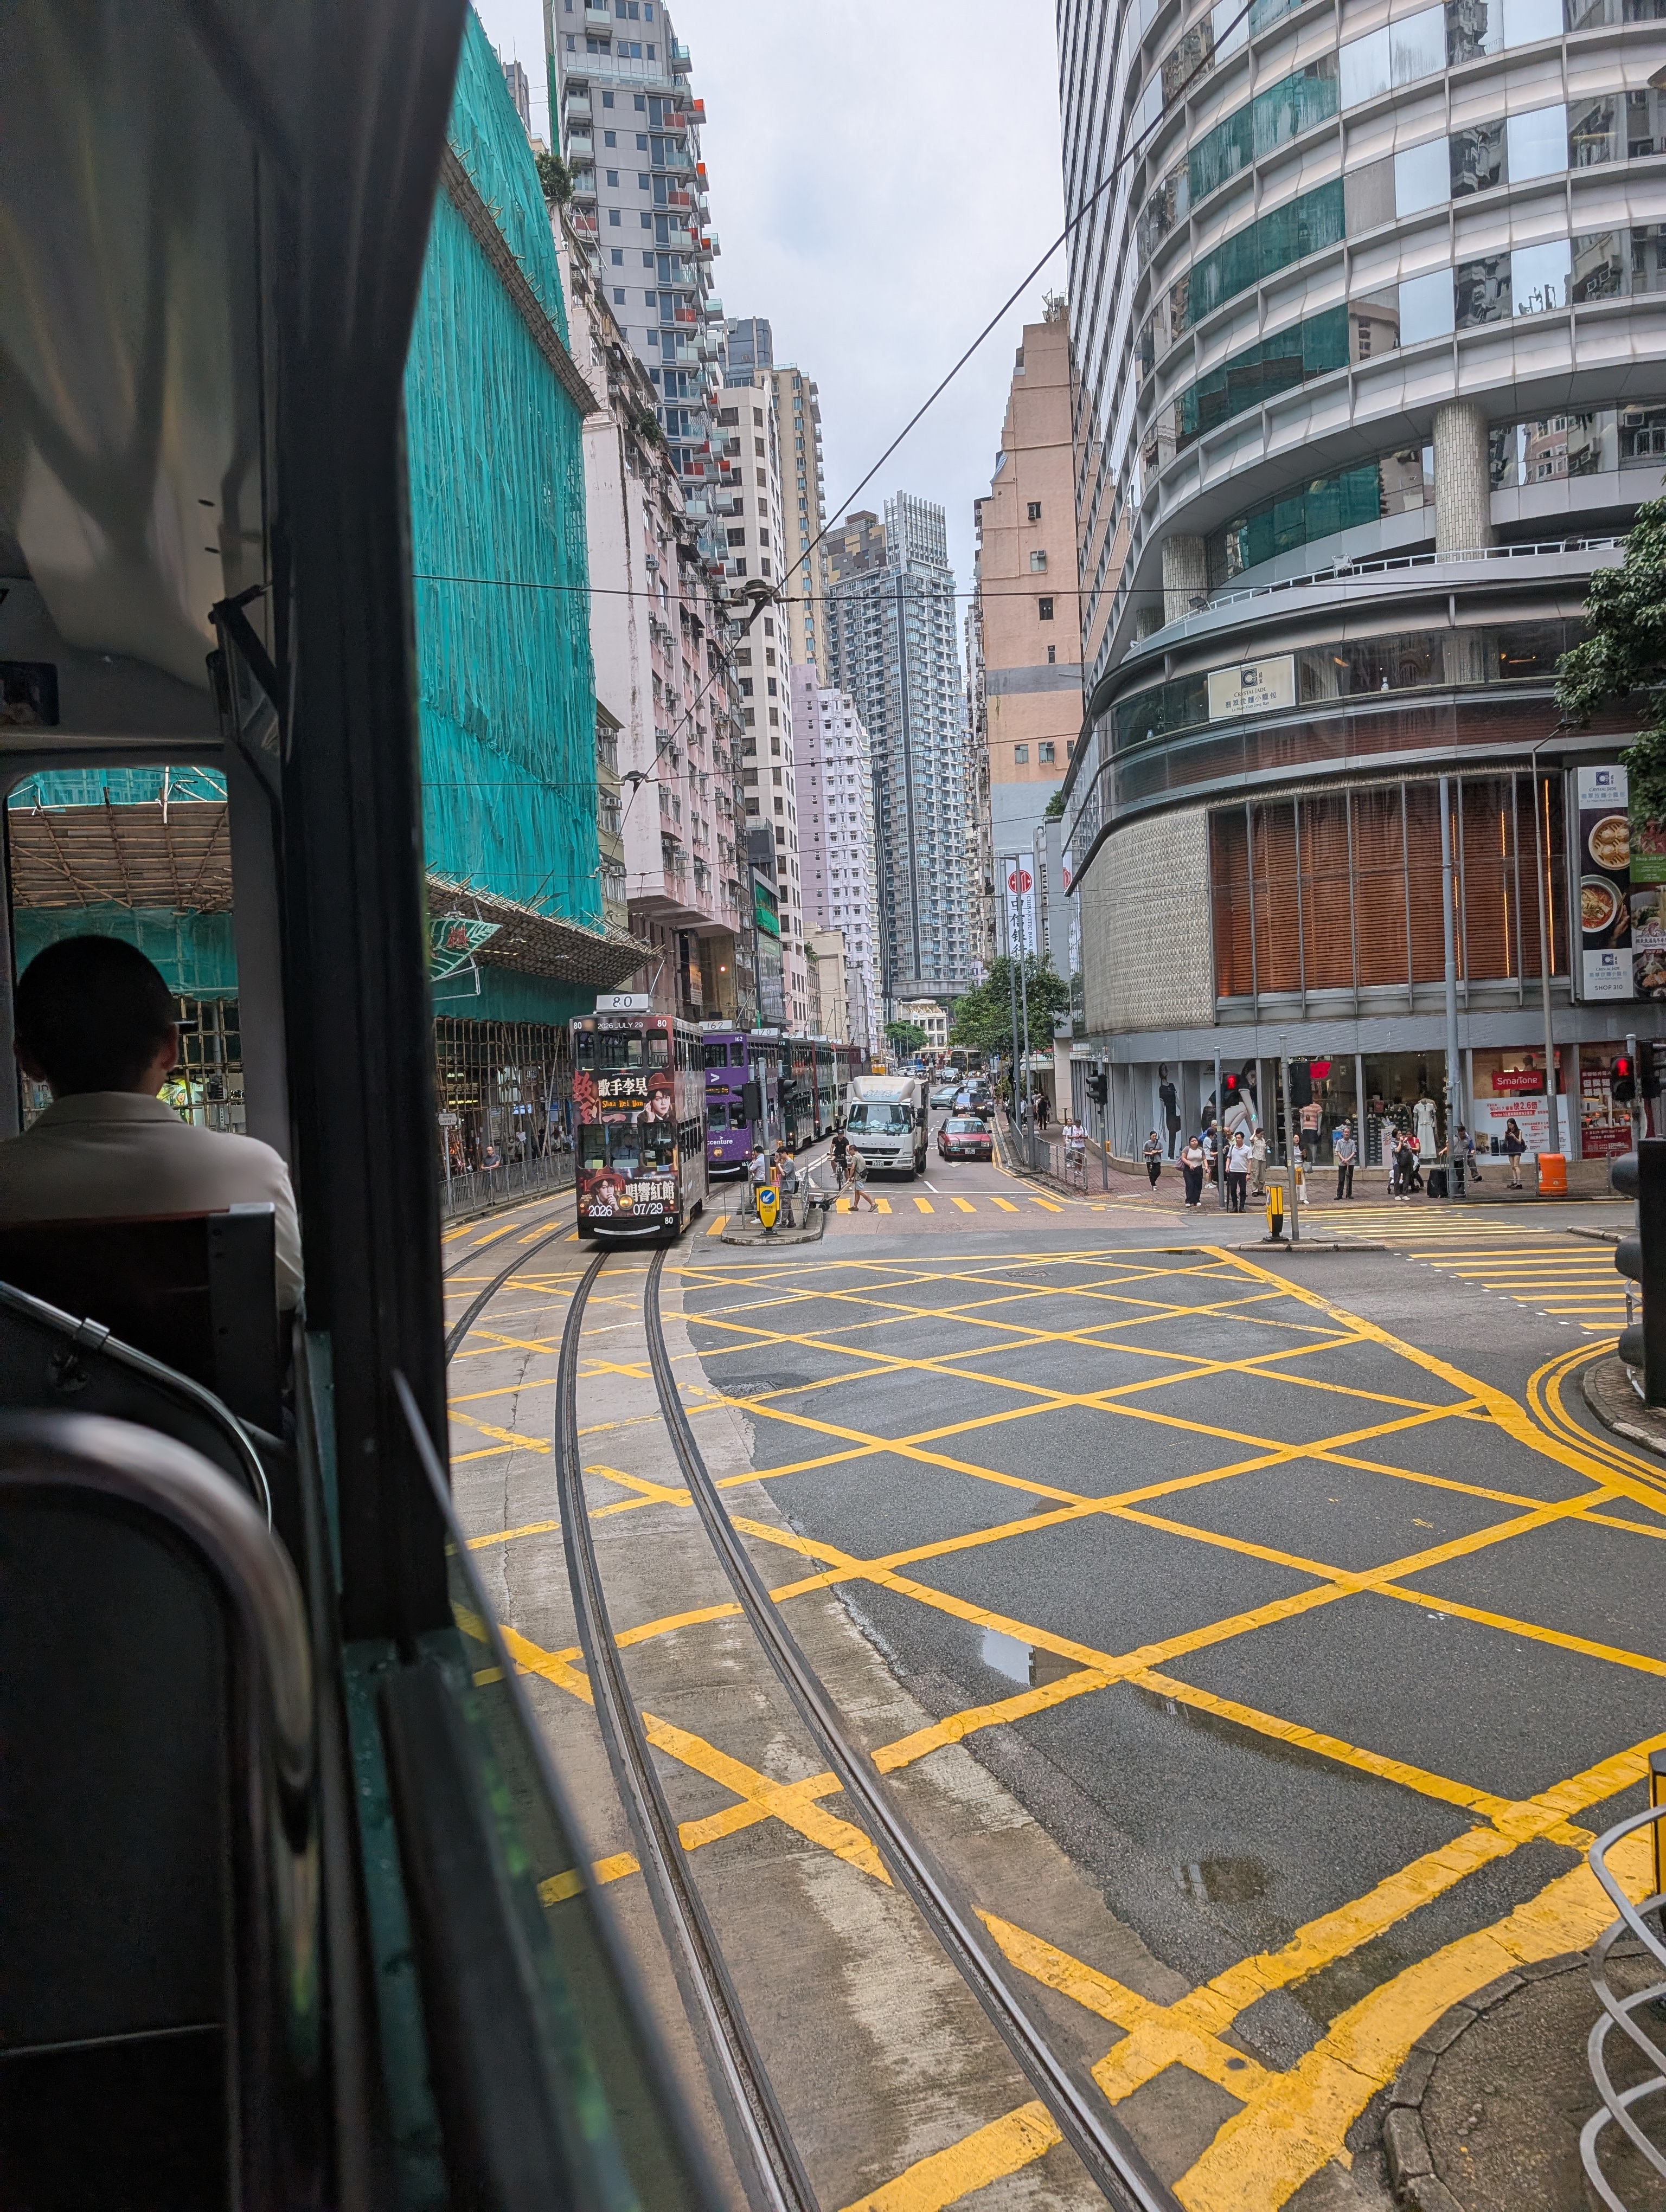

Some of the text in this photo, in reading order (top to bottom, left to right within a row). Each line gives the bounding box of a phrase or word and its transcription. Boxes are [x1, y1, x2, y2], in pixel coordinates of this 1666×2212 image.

[1234, 689, 1254, 697] CRYSTAL
[612, 996, 632, 1008] 80
[573, 1021, 582, 1030] 80
[707, 1021, 723, 1030] 162
[1497, 1076, 1537, 1085] SmarTone
[598, 1077, 649, 1097] 歌手李昊
[1513, 1101, 1538, 1110] 快2.6倍
[588, 1203, 663, 1217] 2026 07/29
